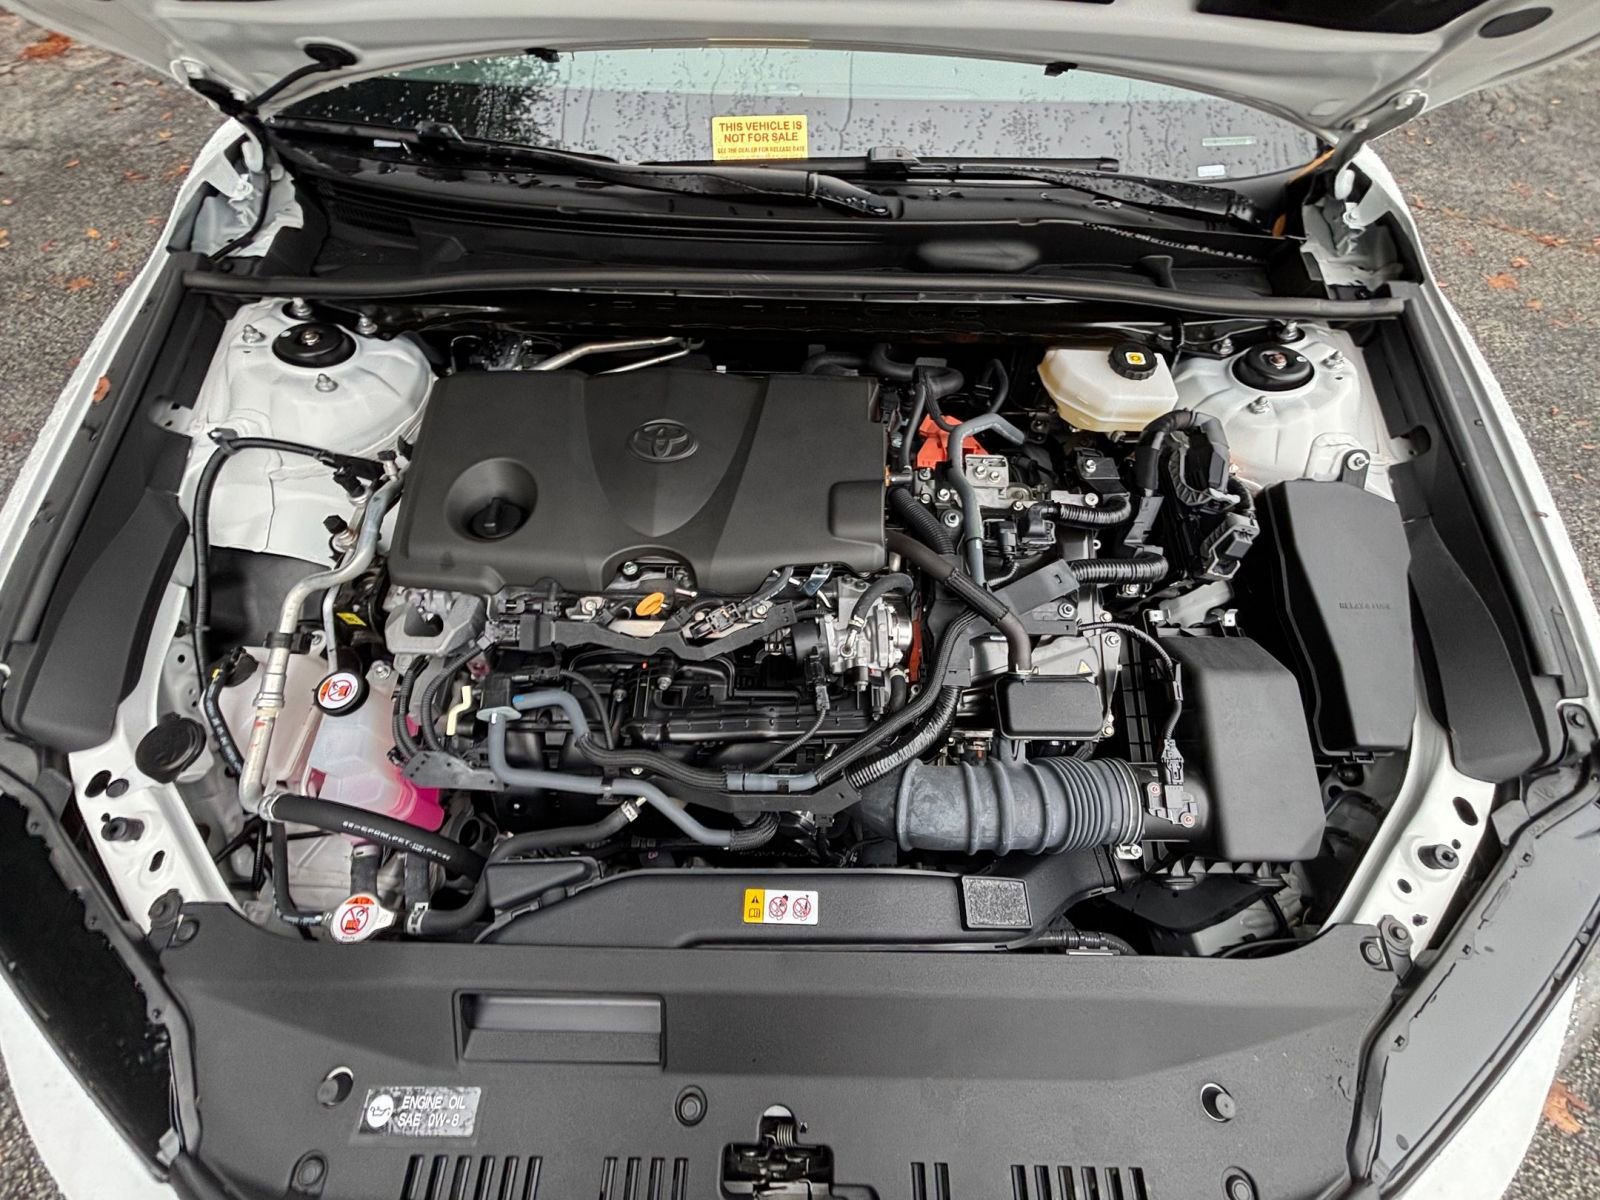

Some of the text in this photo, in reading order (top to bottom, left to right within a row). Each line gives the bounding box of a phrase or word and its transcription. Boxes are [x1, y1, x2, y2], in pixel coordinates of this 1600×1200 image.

[719, 121, 803, 132] THIS VEHICLE IS
[724, 132, 798, 143] NOT FOR SALE
[401, 1095, 466, 1109] ENGINE OIL
[397, 1112, 460, 1127] SAE 0W-8
